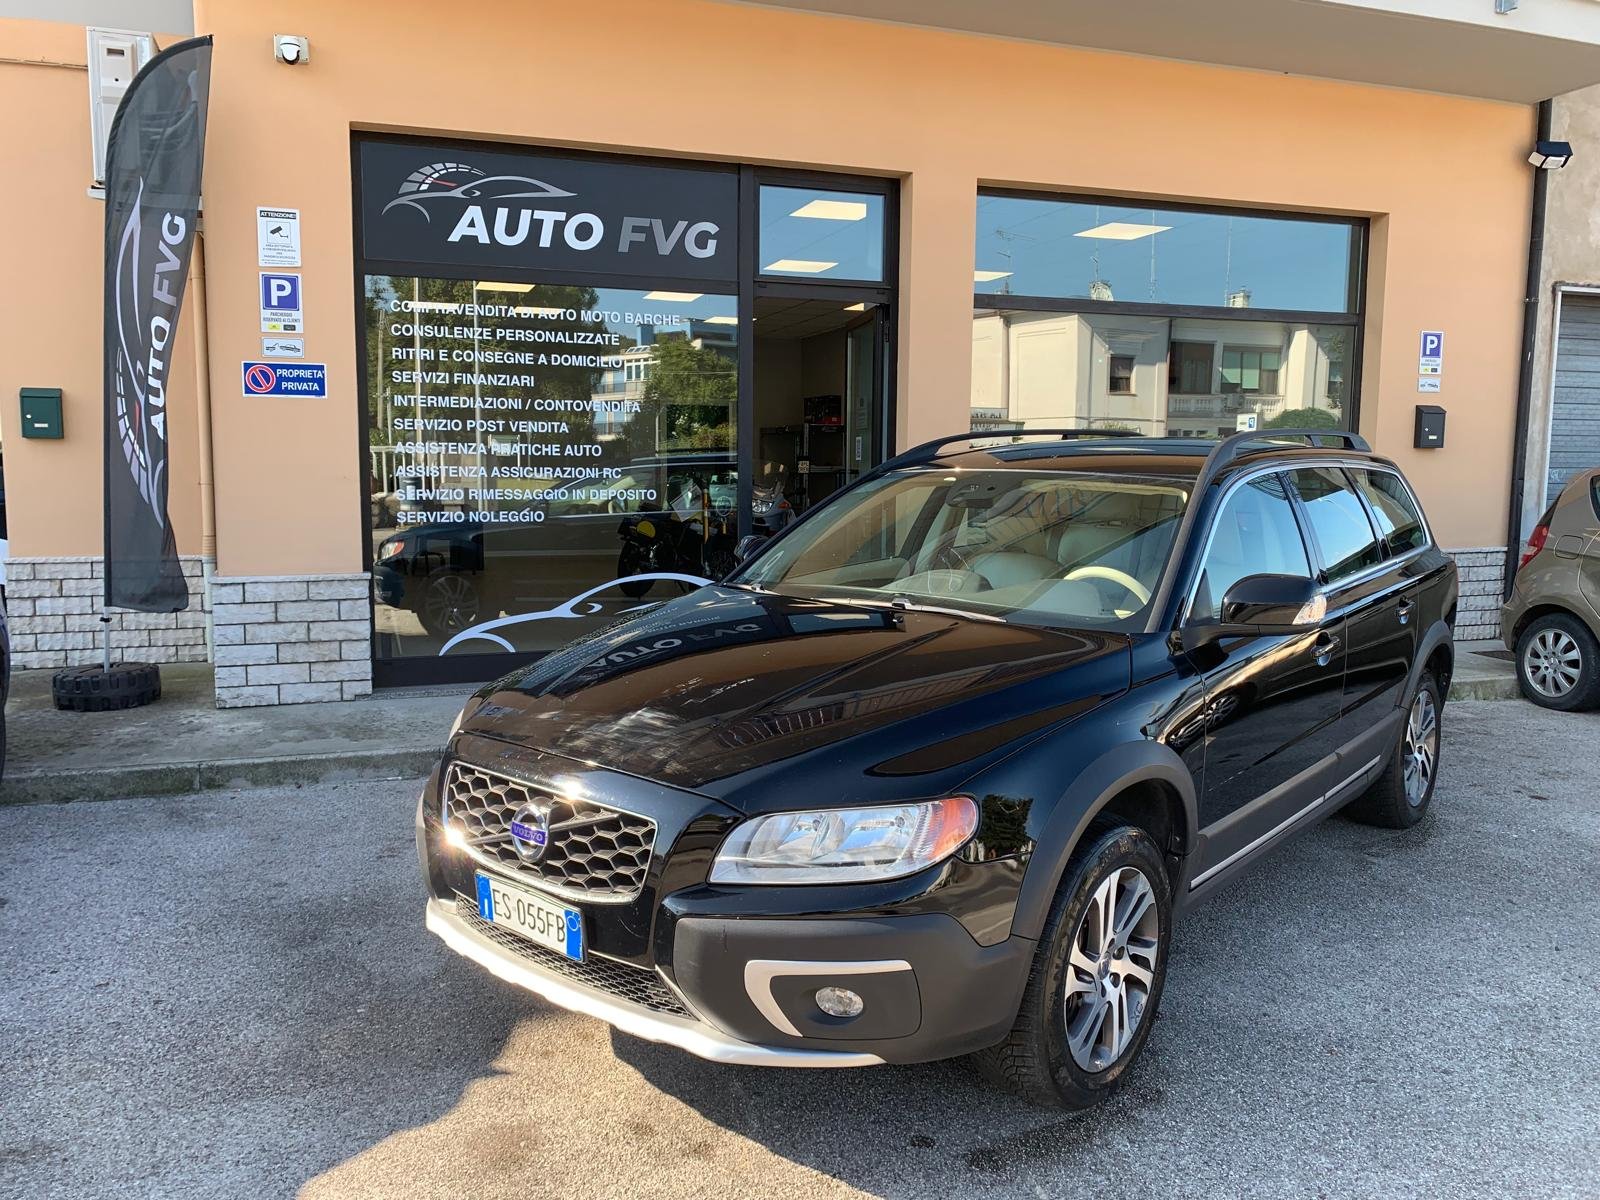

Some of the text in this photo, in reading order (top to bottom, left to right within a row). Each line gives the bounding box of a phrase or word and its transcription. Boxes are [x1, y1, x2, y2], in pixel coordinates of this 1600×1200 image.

[447, 205, 720, 259] AUTO FVG
[270, 278, 292, 306] P
[390, 300, 680, 326] COMRAVENDITA DI AUTO MOTO BARCHE
[148, 212, 186, 440] AUTO FVG
[391, 324, 620, 345] CONSULENZE PERSONALIZZATE
[1425, 335, 1438, 355] P
[392, 347, 622, 368] RITIRI E CONSEGNE A DOMICILIO
[281, 382, 320, 391] PRIVATA
[392, 371, 534, 387] SERVIZI FINANZIARI
[394, 395, 641, 413] INTERMEDIAZIONI / CONTOVENDITA
[394, 418, 569, 433] SERVIZIO POST VENDITA
[395, 442, 602, 457] ASSISTENZA PRATICHE AUTO
[396, 465, 622, 479] ASSISTENZA ASSICURAZIONI RC
[397, 488, 657, 501] SERVIZIO RIMESSAGGIO IN DEPOSITO
[397, 510, 545, 523] SERVIZIO NOLEGGIO
[513, 823, 544, 842] VOLVO
[492, 889, 512, 920] ES
[516, 898, 566, 943] 055FB
